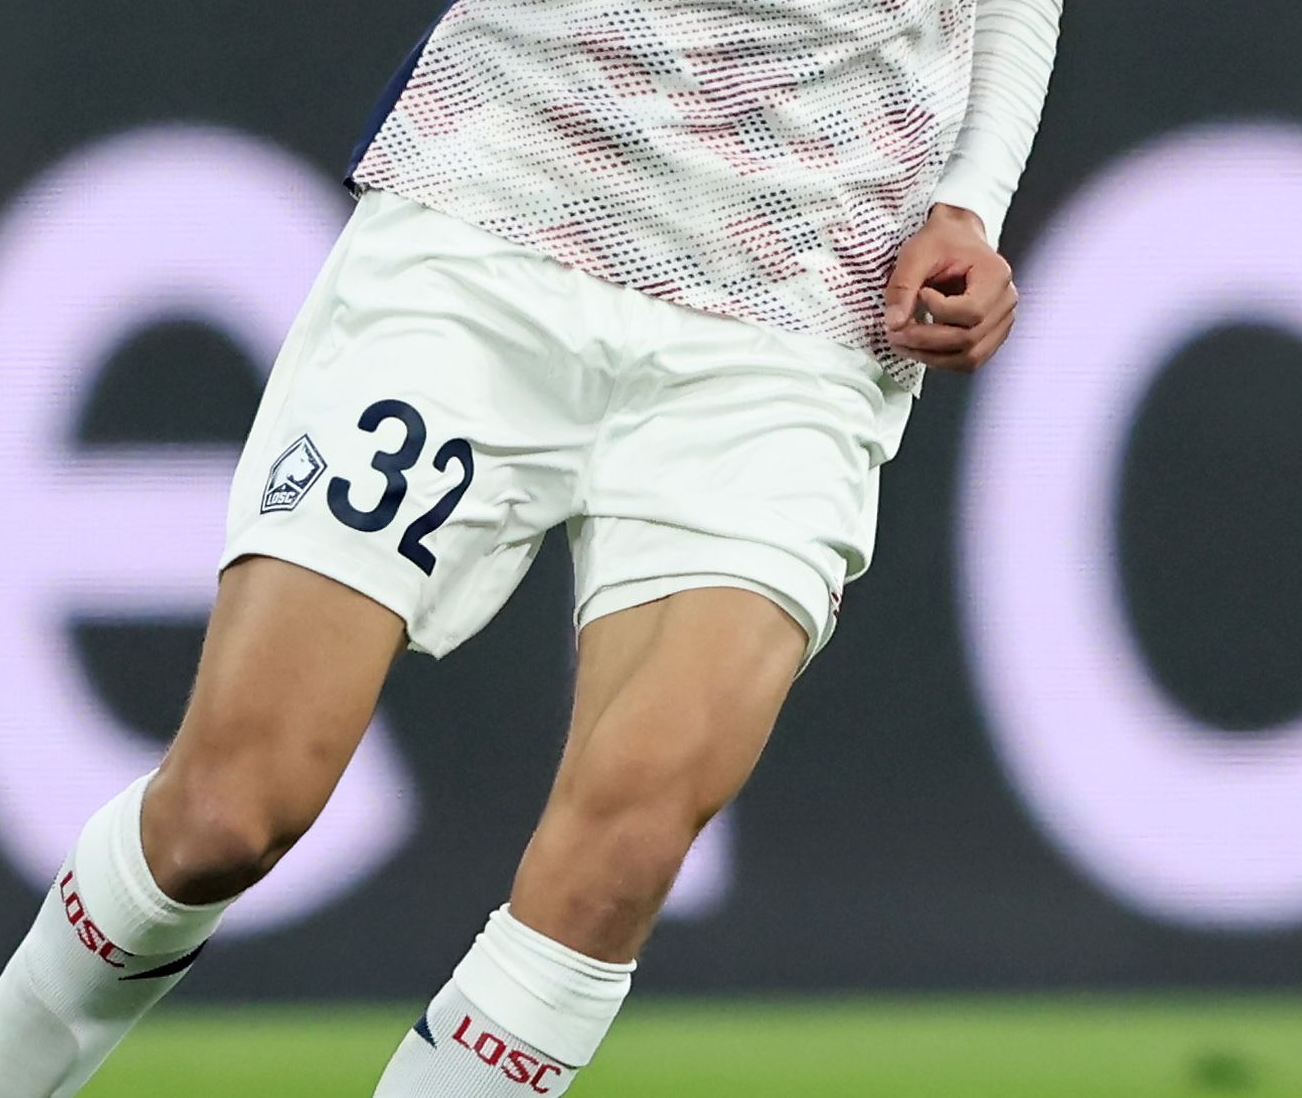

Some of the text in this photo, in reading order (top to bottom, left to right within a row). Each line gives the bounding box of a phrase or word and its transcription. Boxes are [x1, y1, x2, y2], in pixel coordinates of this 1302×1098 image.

[326, 398, 475, 578] 32
[60, 870, 129, 968] LOSC
[451, 1014, 562, 1095] LOSC
